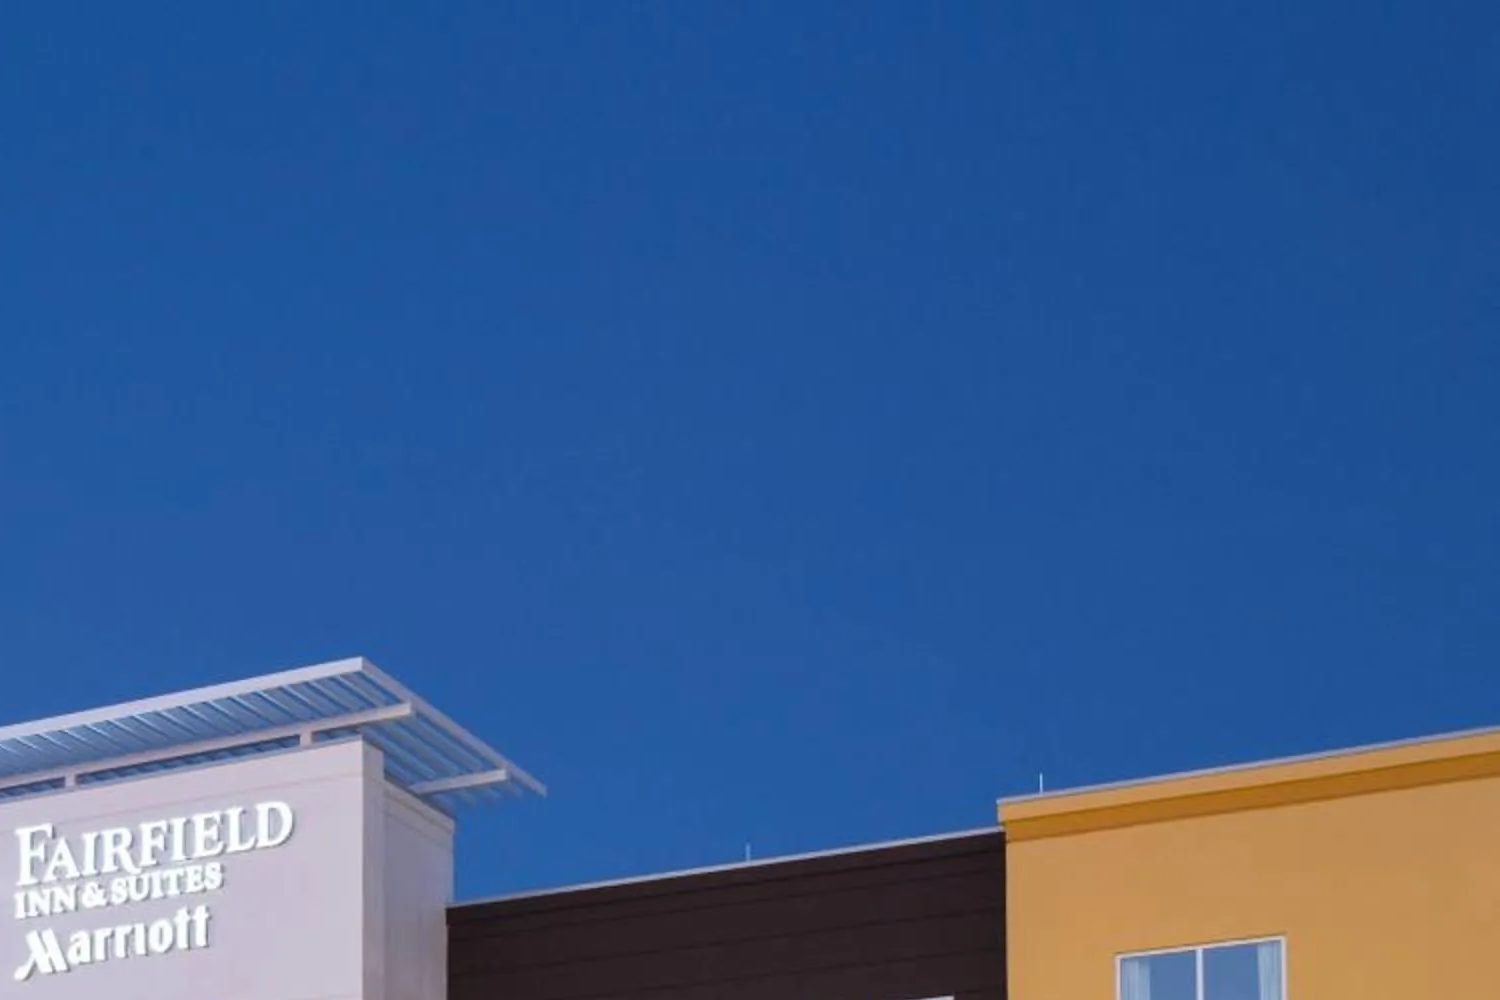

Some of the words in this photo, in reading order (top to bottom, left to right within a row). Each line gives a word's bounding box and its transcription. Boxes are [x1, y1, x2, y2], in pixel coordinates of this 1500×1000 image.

[14, 801, 296, 887] FAIRFIELD
[14, 884, 77, 919] INN
[81, 880, 108, 908] &
[111, 862, 224, 906] SUITES
[13, 904, 212, 982] Marriott
